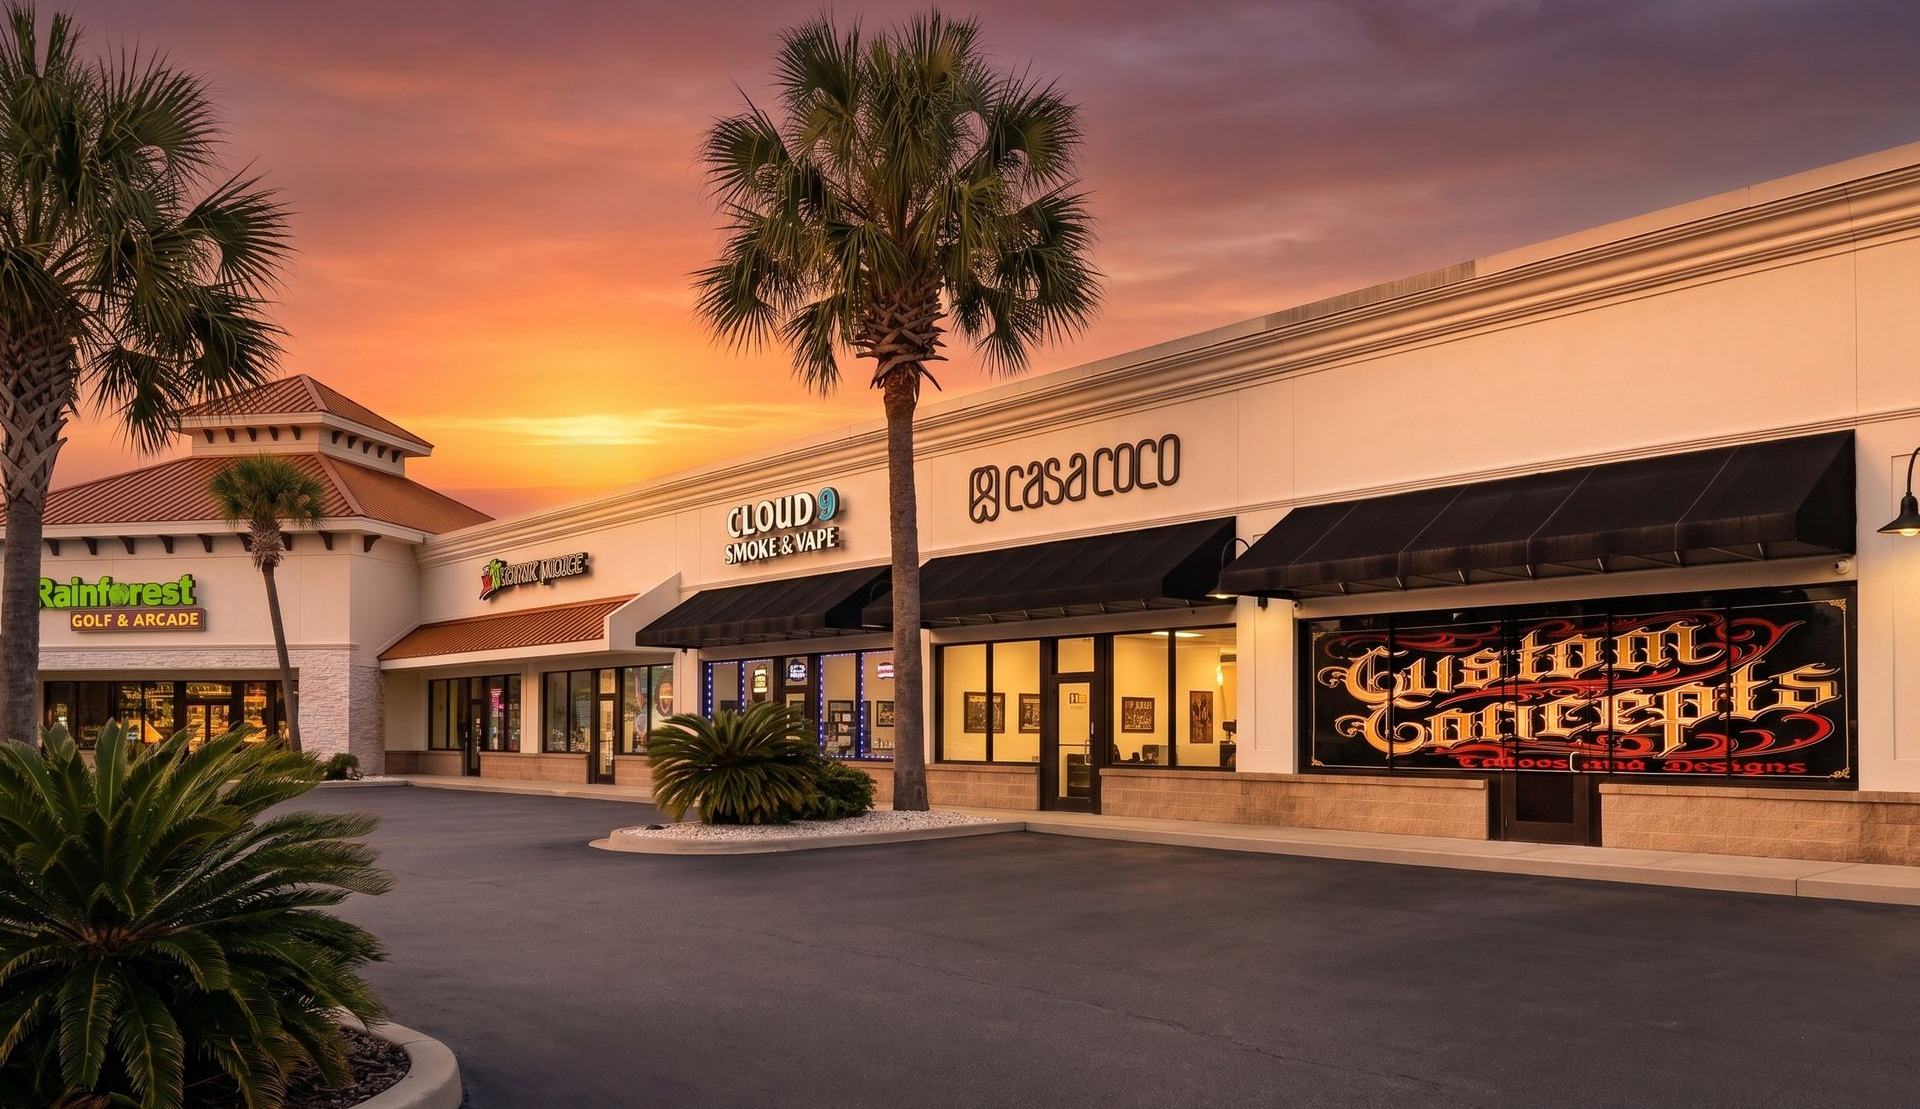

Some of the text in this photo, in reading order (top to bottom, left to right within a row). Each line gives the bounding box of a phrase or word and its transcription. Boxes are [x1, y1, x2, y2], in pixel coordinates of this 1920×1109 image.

[726, 487, 839, 538] CLOUD 9
[725, 527, 837, 564] SMOKE & VAPE
[39, 574, 195, 608] Rainforest
[72, 612, 199, 627] GOLF & ARCADE
[1318, 621, 1725, 704] Custom
[1334, 660, 1841, 758] Concepts
[1662, 760, 1807, 775] Designs
